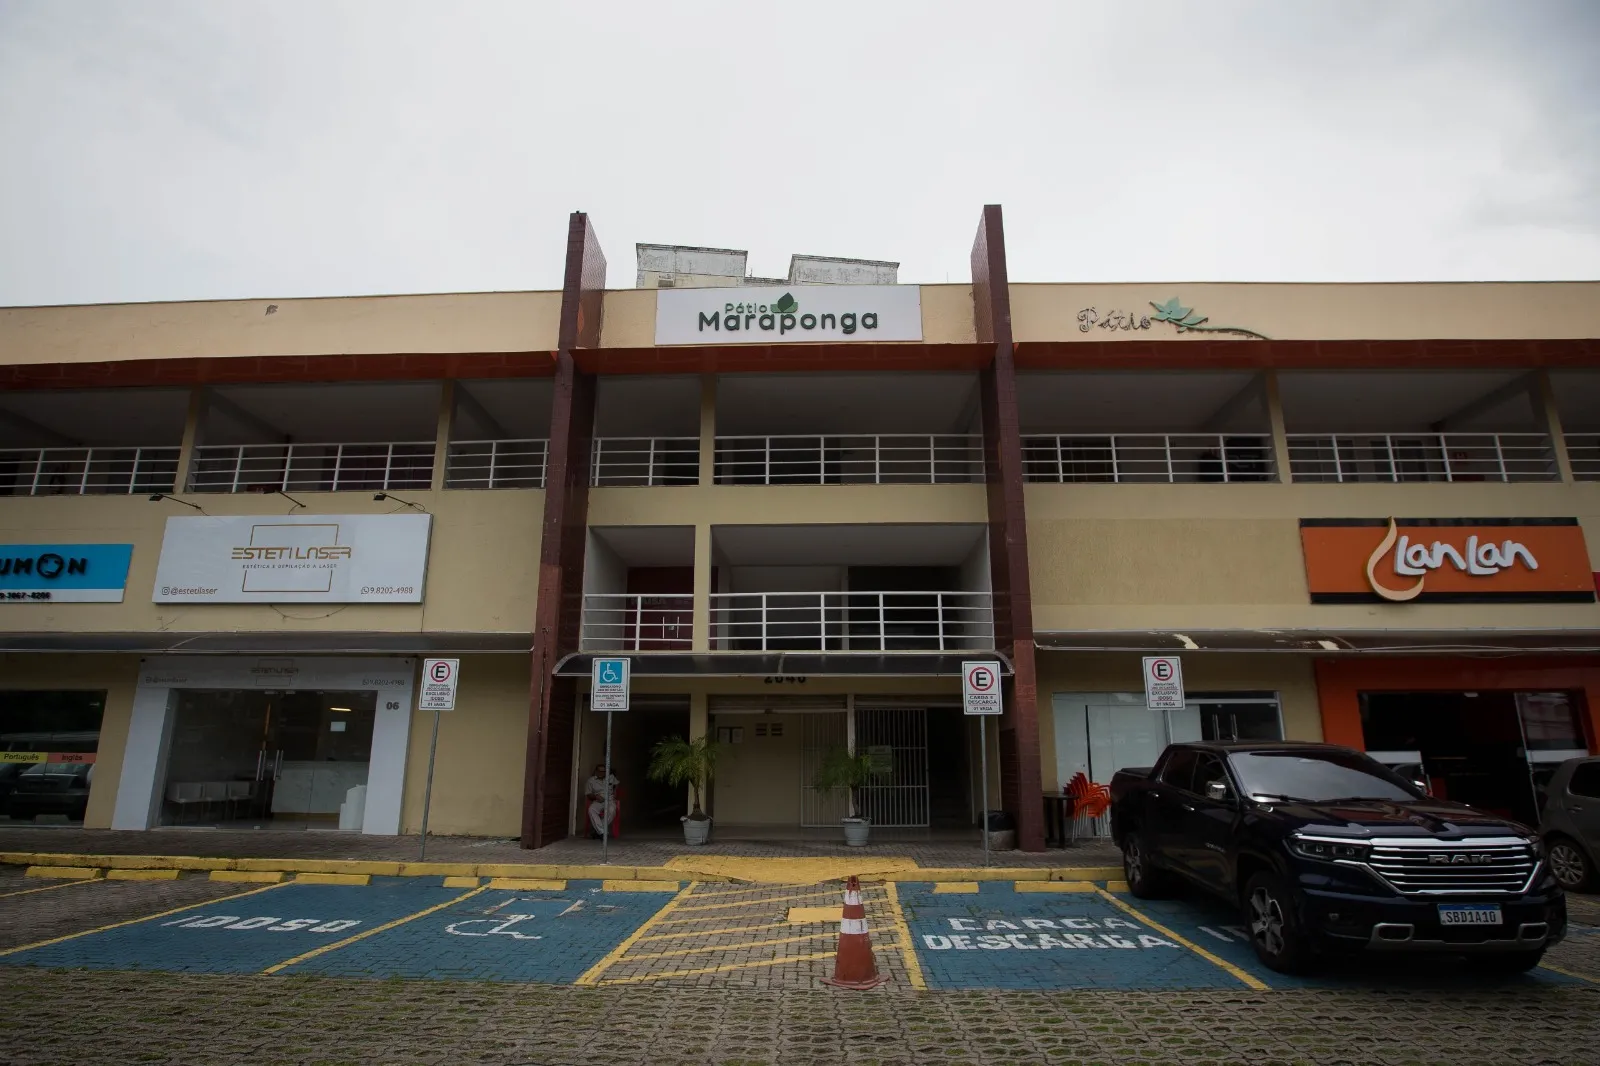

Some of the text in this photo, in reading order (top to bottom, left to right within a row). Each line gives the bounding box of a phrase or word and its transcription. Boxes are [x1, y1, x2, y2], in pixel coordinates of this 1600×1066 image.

[725, 302, 768, 314] Pátio
[698, 310, 878, 335] Maraponga
[170, 586, 218, 596] @estetilaser
[435, 666, 445, 678] E
[1157, 663, 1168, 677] E
[976, 672, 988, 686] E
[386, 701, 400, 710] 06
[3, 753, 40, 762] Português
[1428, 854, 1492, 864] RAM
[1445, 911, 1497, 923] SBD1A10
[160, 915, 363, 933] IDOSO
[948, 916, 1142, 931] CARGA
[922, 933, 1181, 950] DESCARGA
